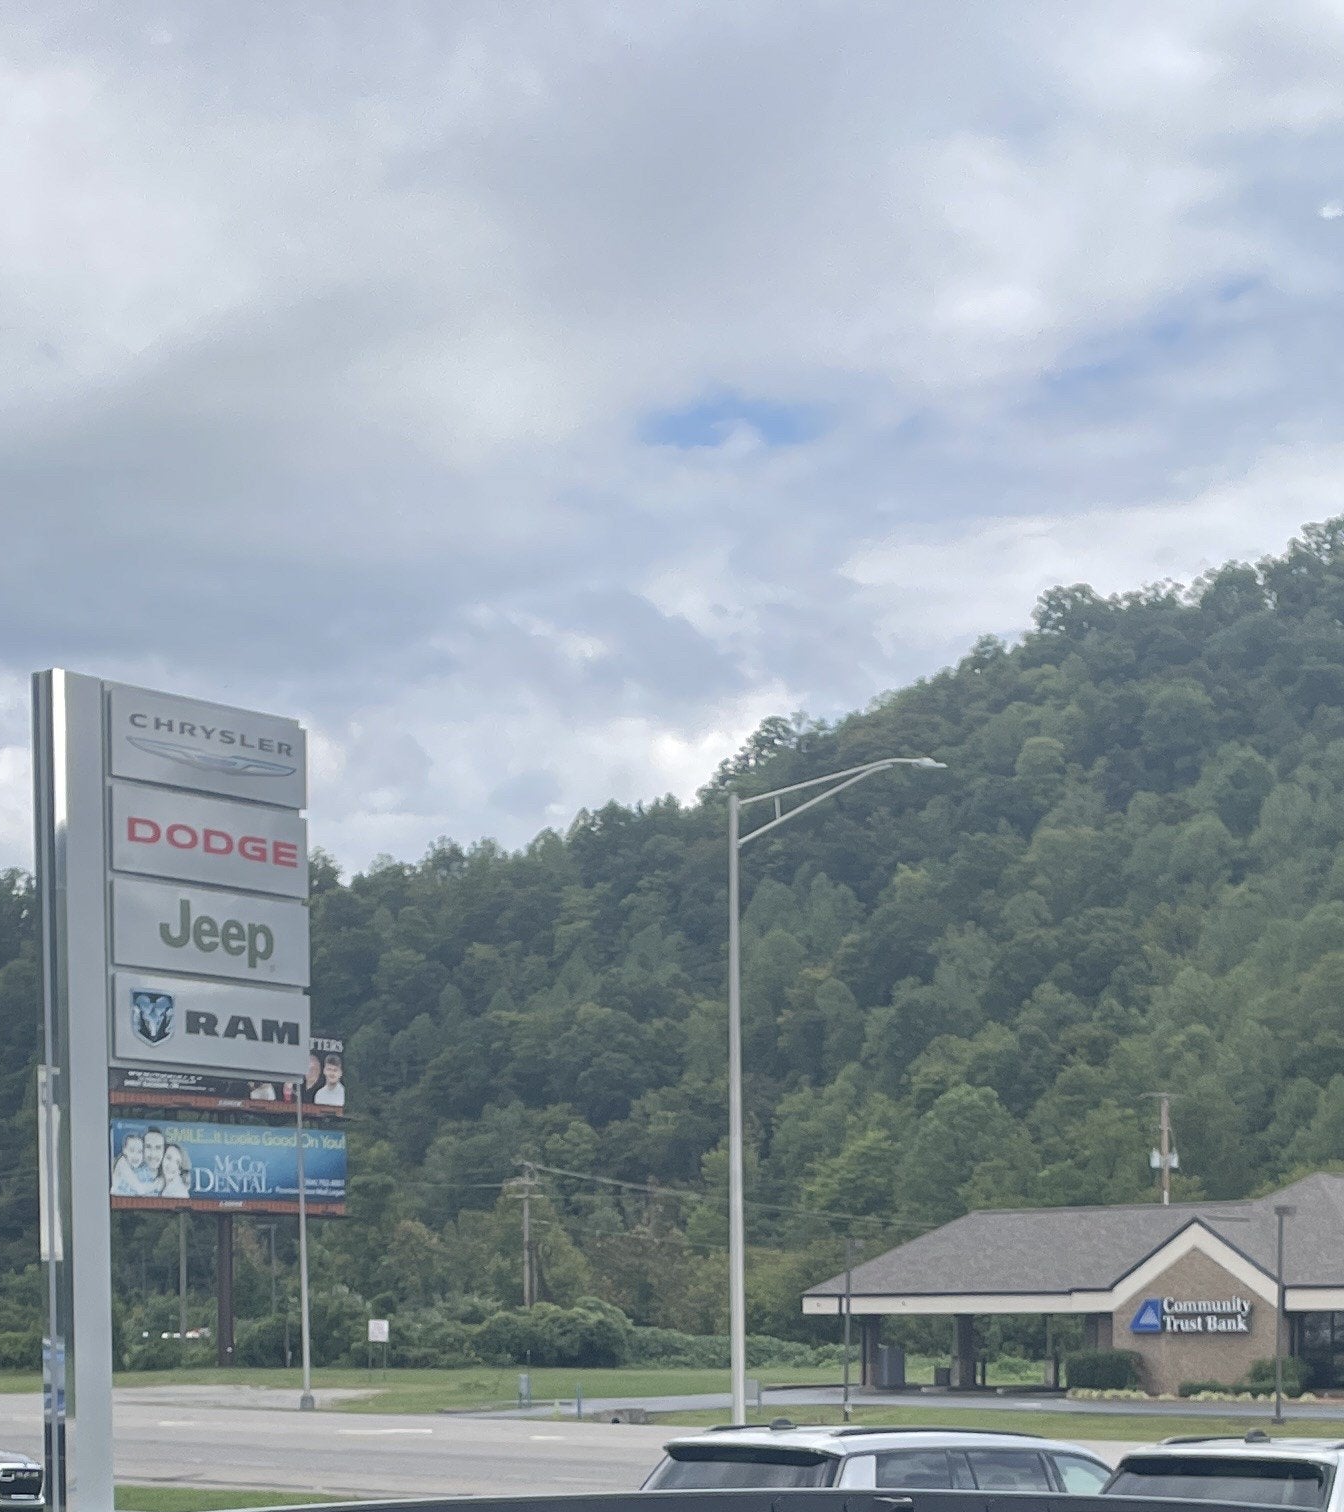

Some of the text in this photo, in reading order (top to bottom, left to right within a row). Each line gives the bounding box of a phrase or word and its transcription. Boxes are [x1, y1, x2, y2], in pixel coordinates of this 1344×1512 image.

[129, 713, 293, 757] CHRYSLER
[127, 816, 298, 869] DODGE
[159, 898, 274, 968] Jeep
[185, 1009, 300, 1046] RAM
[308, 1037, 344, 1053] TTERS
[262, 1130, 297, 1147] Good
[194, 1166, 272, 1193] DENTAL
[1163, 1296, 1250, 1316] Community
[1163, 1314, 1249, 1332] Trust Bank
